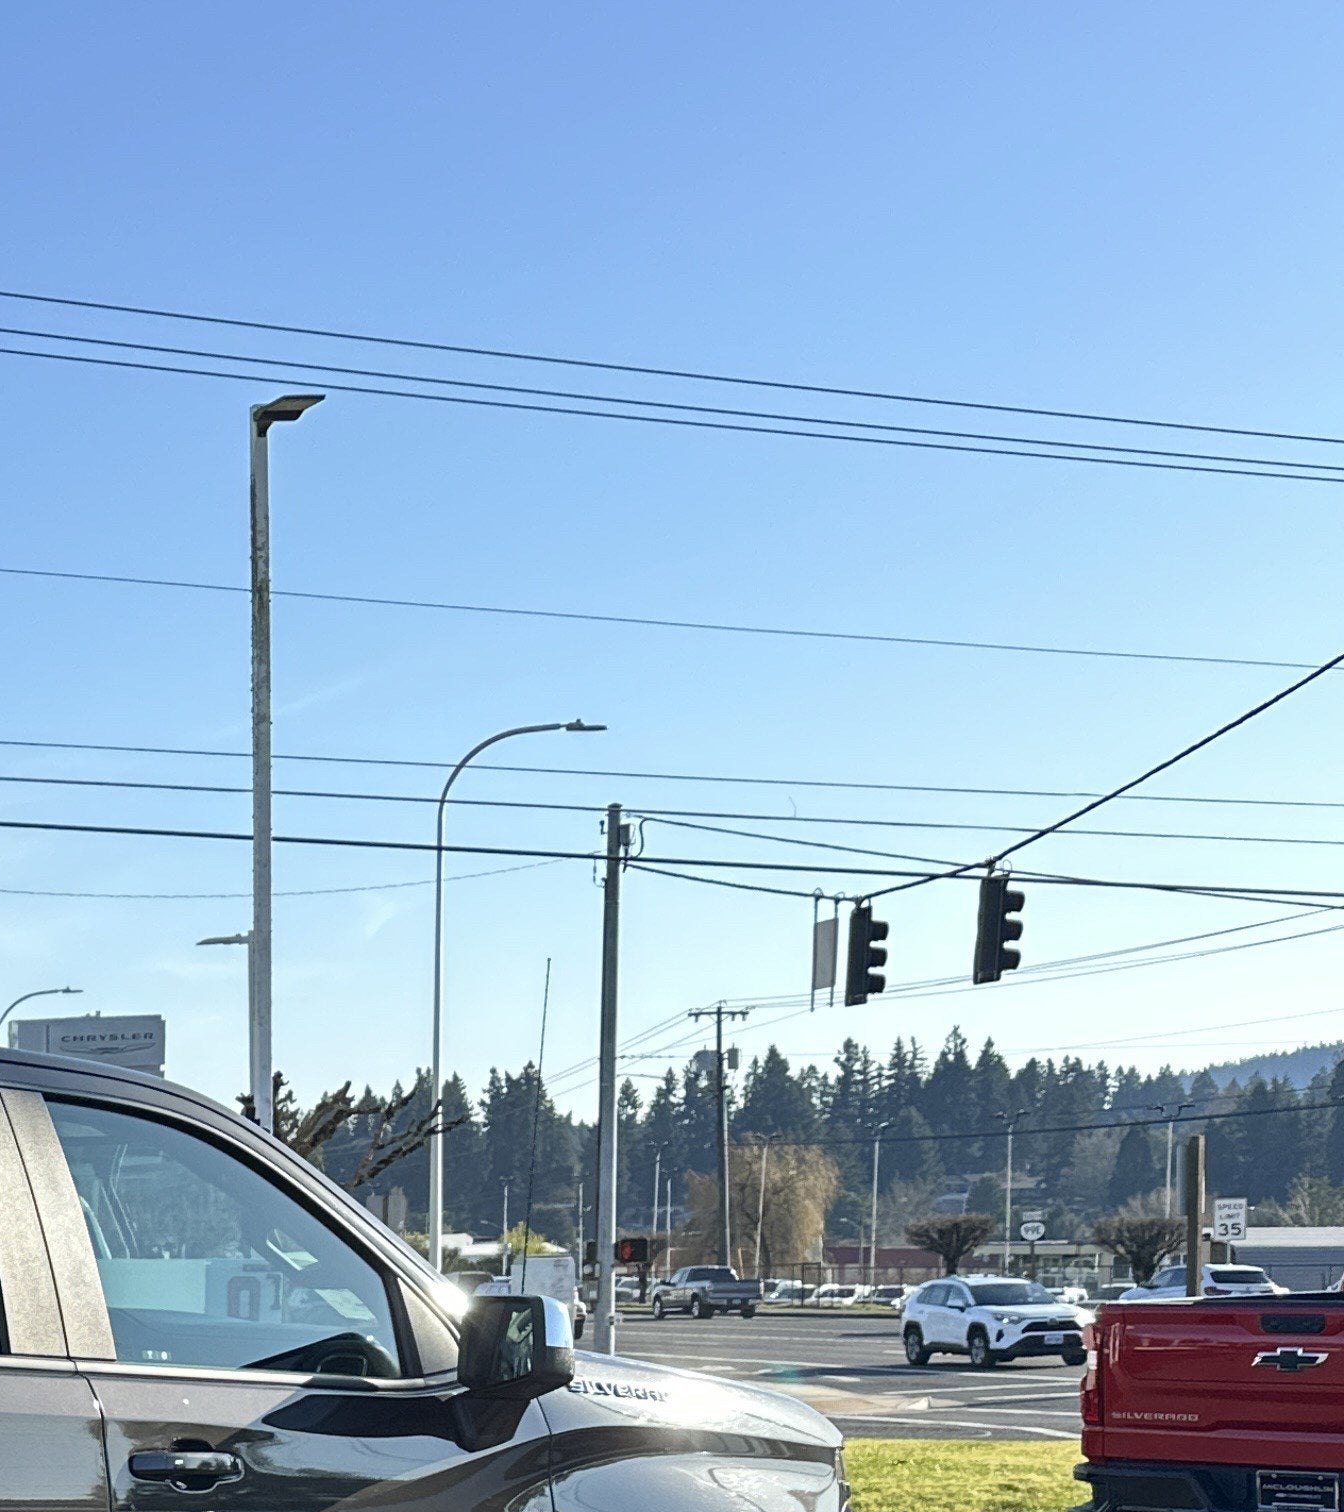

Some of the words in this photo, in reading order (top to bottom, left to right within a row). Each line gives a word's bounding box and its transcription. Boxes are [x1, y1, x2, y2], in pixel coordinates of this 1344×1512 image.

[61, 1032, 154, 1043] CHRYSLER
[1218, 1223, 1242, 1236] 35
[1111, 1411, 1200, 1422] SILVERADO
